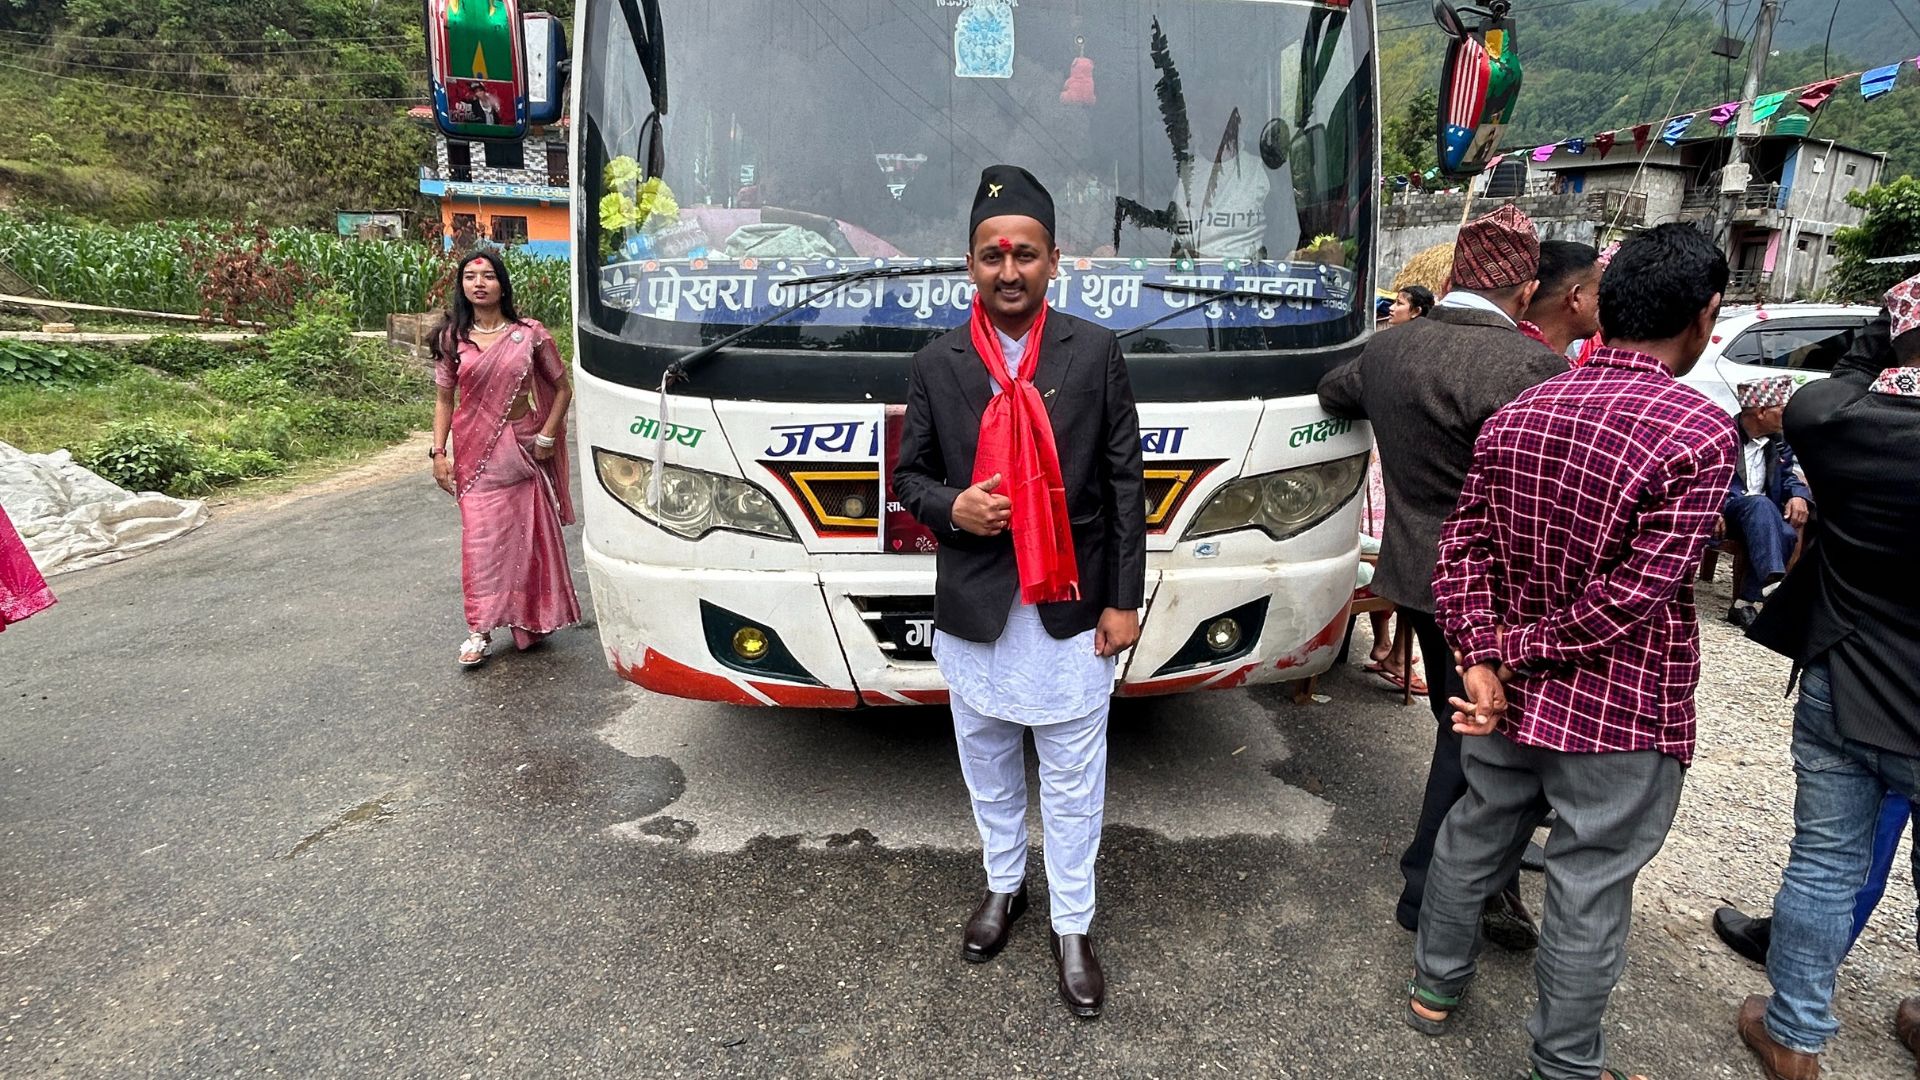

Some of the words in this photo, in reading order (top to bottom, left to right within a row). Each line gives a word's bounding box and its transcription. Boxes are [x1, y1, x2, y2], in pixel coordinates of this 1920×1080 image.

[648, 266, 757, 312] पोखरा
[1081, 274, 1143, 319] थुम
[629, 415, 706, 448] भाग्य
[764, 421, 864, 457] जय
[1139, 426, 1189, 454] बा
